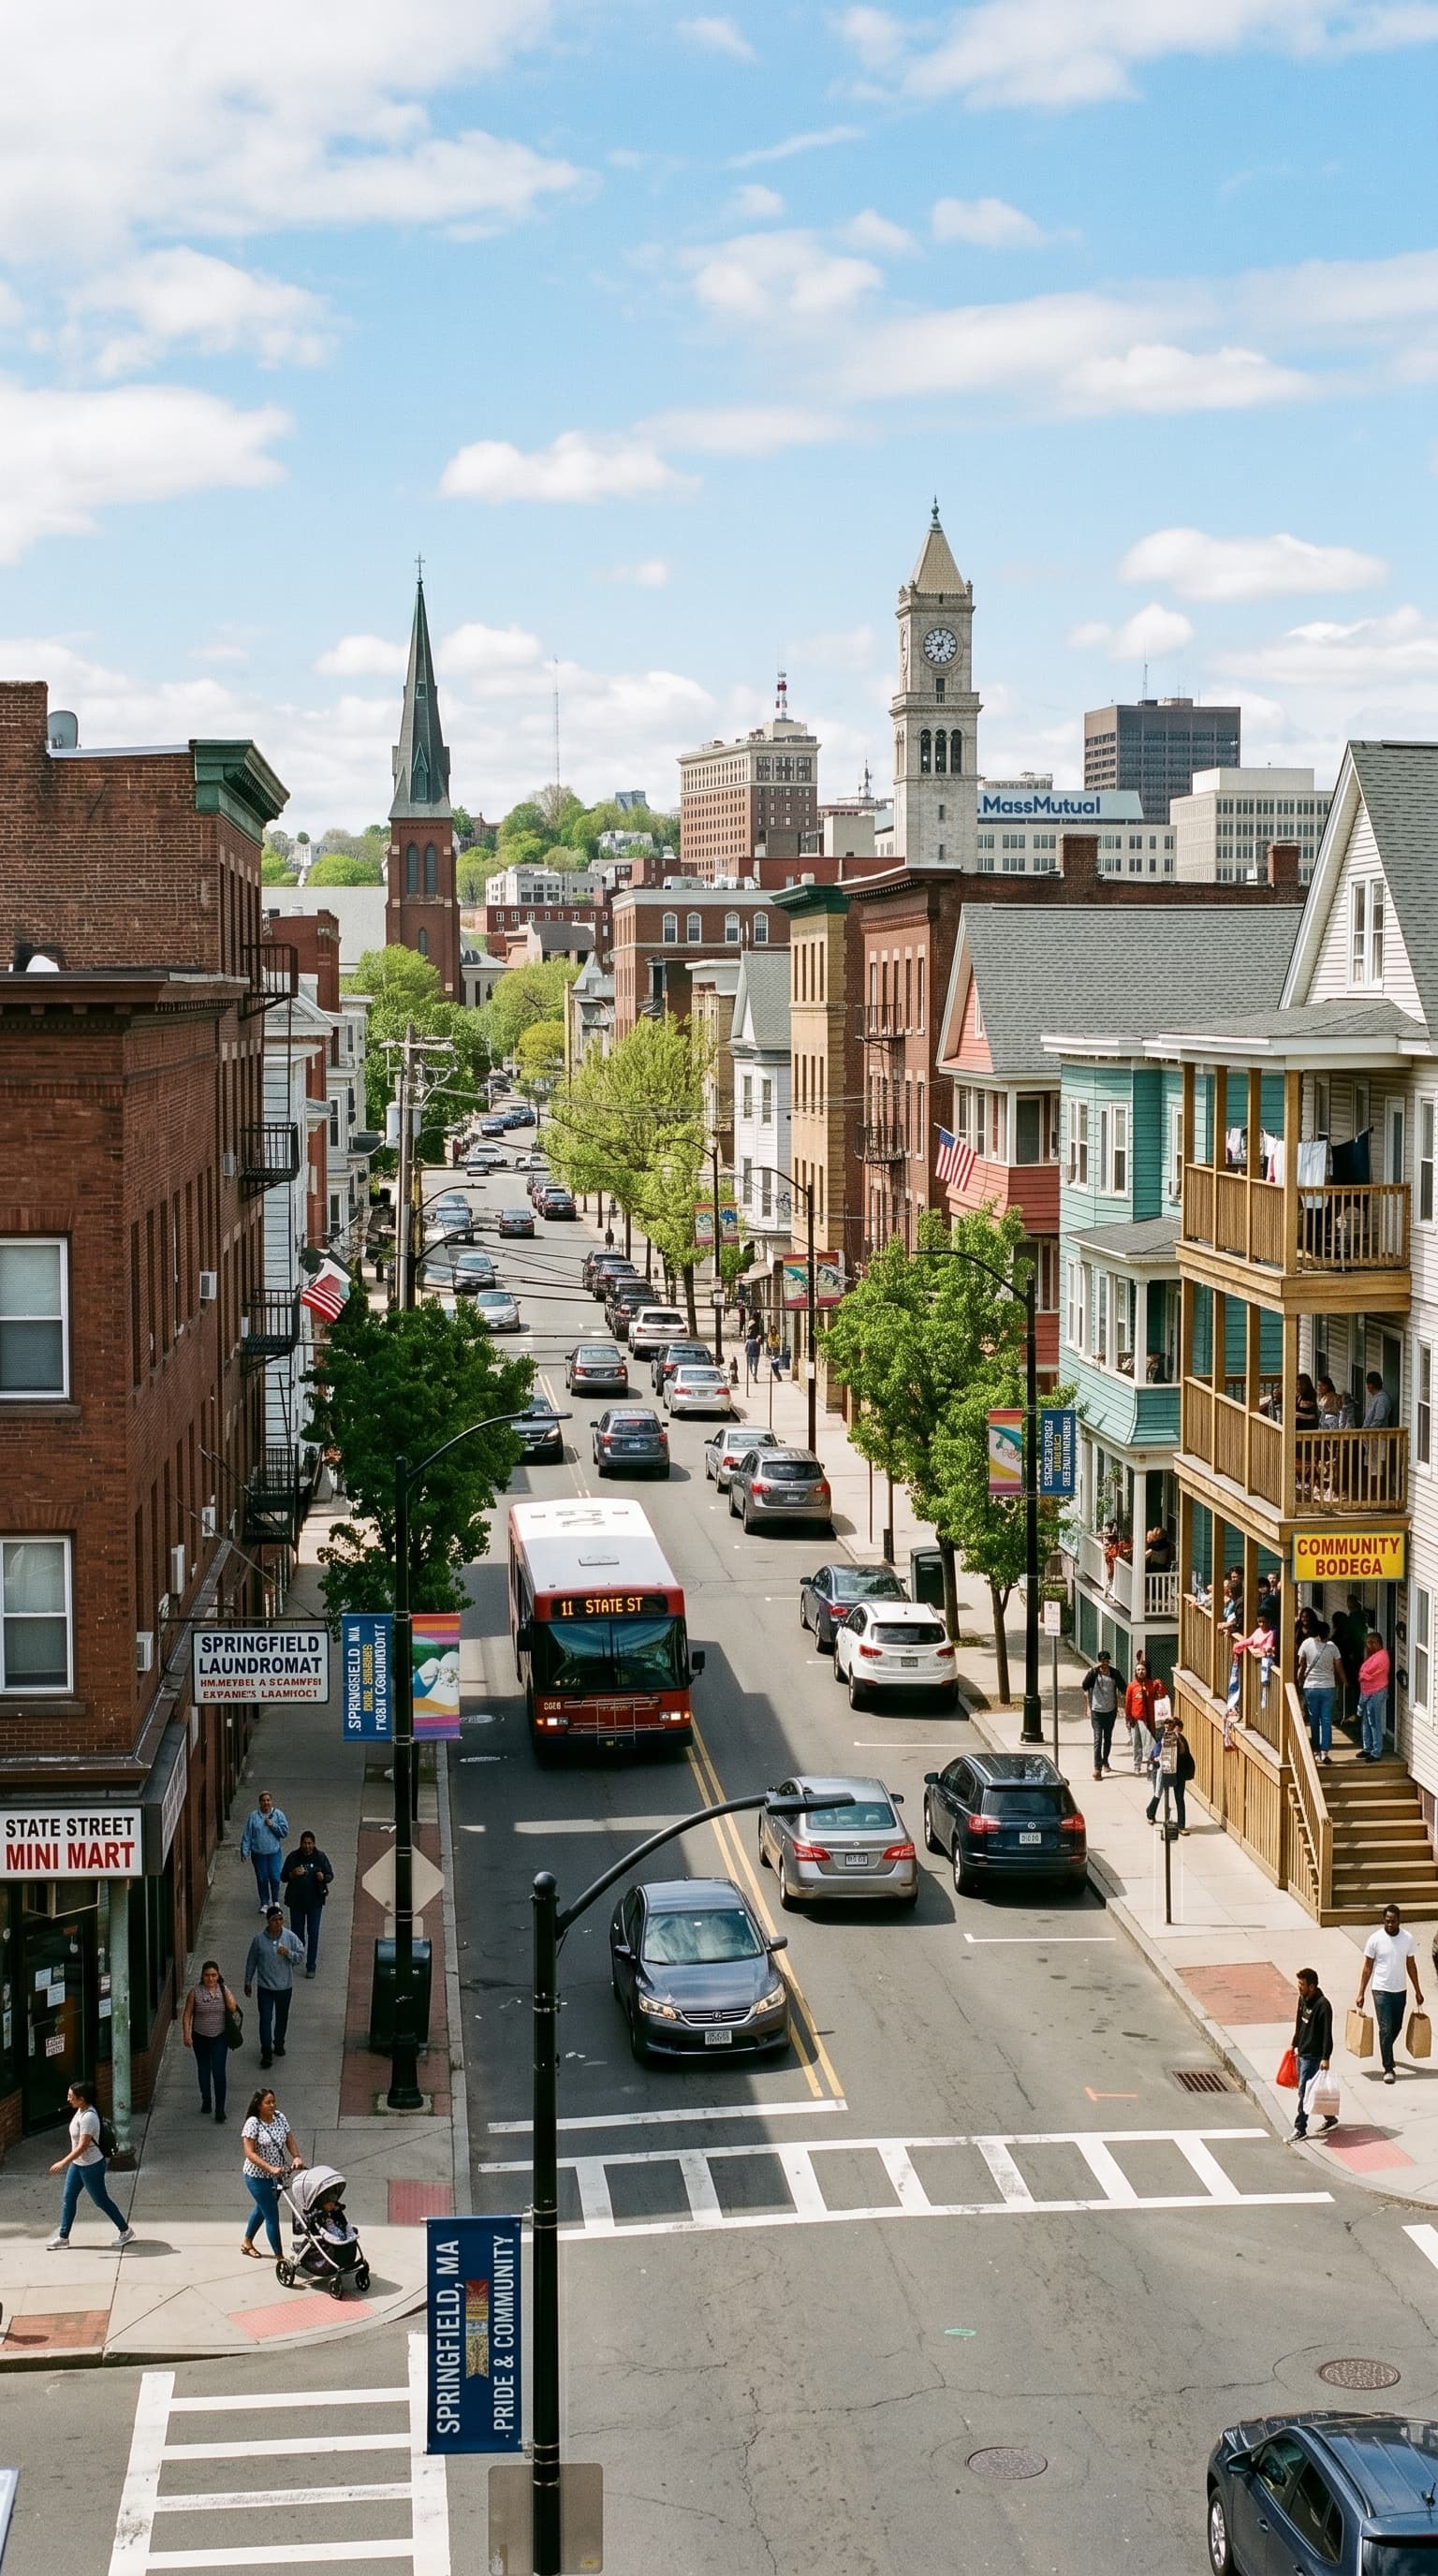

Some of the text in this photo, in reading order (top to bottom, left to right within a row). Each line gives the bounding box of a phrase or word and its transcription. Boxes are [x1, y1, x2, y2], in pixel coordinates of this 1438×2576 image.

[983, 796, 1101, 814] MassMutual
[1298, 1537, 1401, 1556] COMMUNITY
[1315, 1559, 1383, 1575] BODEGA
[562, 1597, 643, 1617] 11 STATE ST
[201, 1636, 319, 1653] SPRINGFIELD
[199, 1657, 322, 1675] LAUNDROMAT
[6, 1817, 134, 1837] STATE STREET
[6, 1842, 135, 1870] MINI MART
[436, 2240, 464, 2434] SPRINGFIELD, MA
[493, 2235, 514, 2430] PRIDE & COMMUNITY
